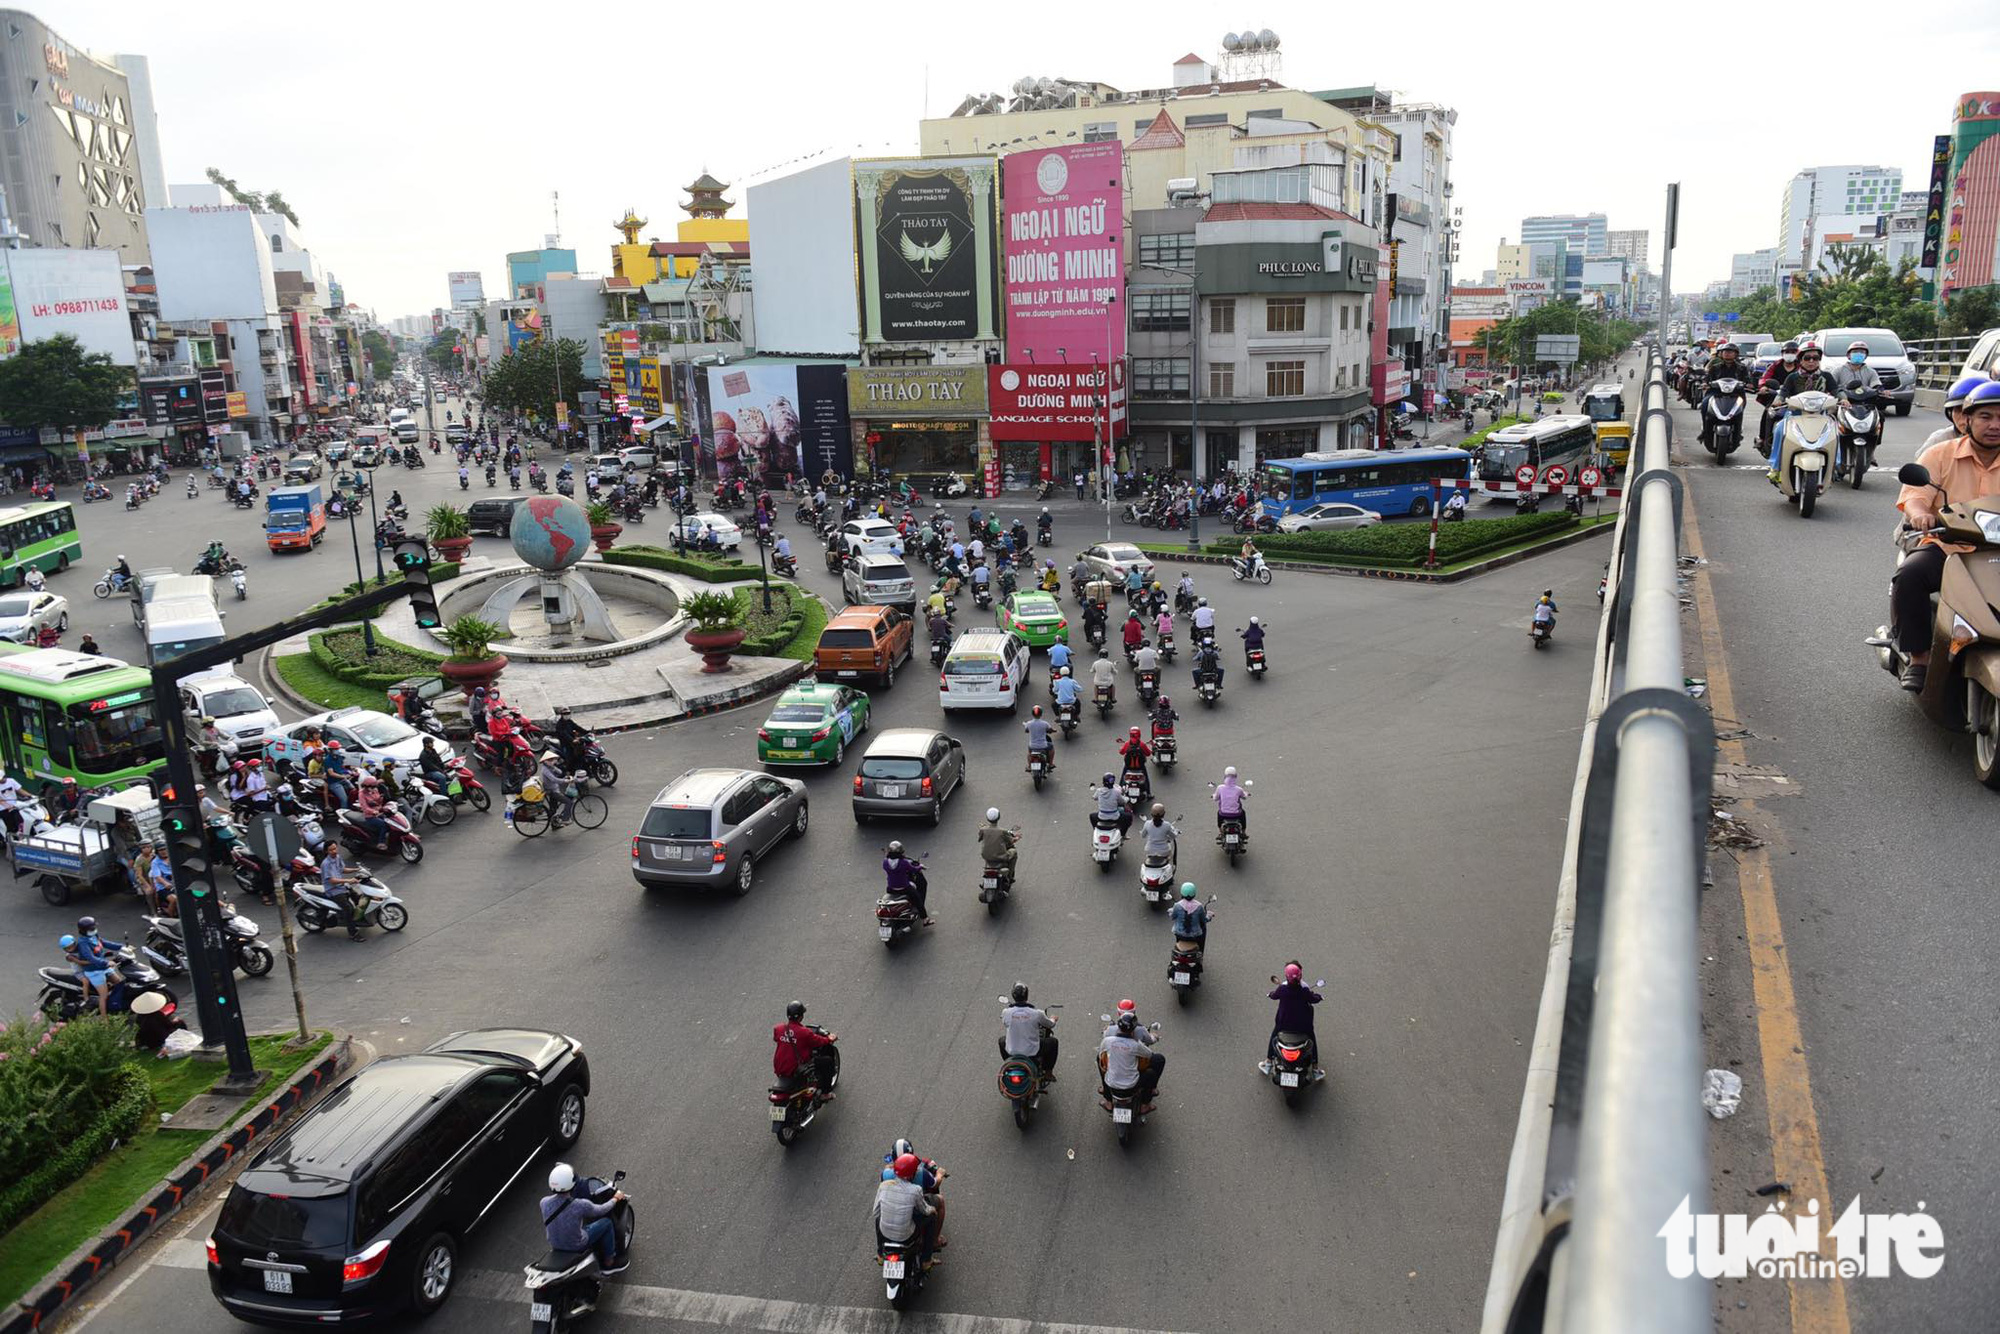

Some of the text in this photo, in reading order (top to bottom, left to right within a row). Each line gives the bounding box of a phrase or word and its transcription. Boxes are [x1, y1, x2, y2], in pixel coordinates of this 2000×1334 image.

[74, 94, 100, 117] IMAX
[901, 217, 948, 228] THẢO TÂY
[1011, 198, 1107, 246] NGOẠI NGỮ
[1925, 166, 1943, 266] KARAOKE
[1941, 177, 1967, 299] KARAOKE
[1009, 248, 1117, 283] DƯƠNG MINH
[1259, 261, 1320, 273] PHUC LONG
[884, 290, 905, 299] QUYỀN
[906, 290, 921, 298] NĂNG
[922, 290, 934, 298] CỦA
[1010, 287, 1116, 307] THÀNH LẬP TỪ NĂM 1990
[33, 299, 119, 317] LH: 0988711438
[1016, 307, 1107, 318] www.duongminh.edu.vn
[892, 320, 966, 328] www.thaotay.com
[867, 378, 963, 400] THẢO TÂY
[1028, 370, 1107, 390] NGOẠI NGỮ
[1018, 393, 1107, 408] DƯƠNG MINH
